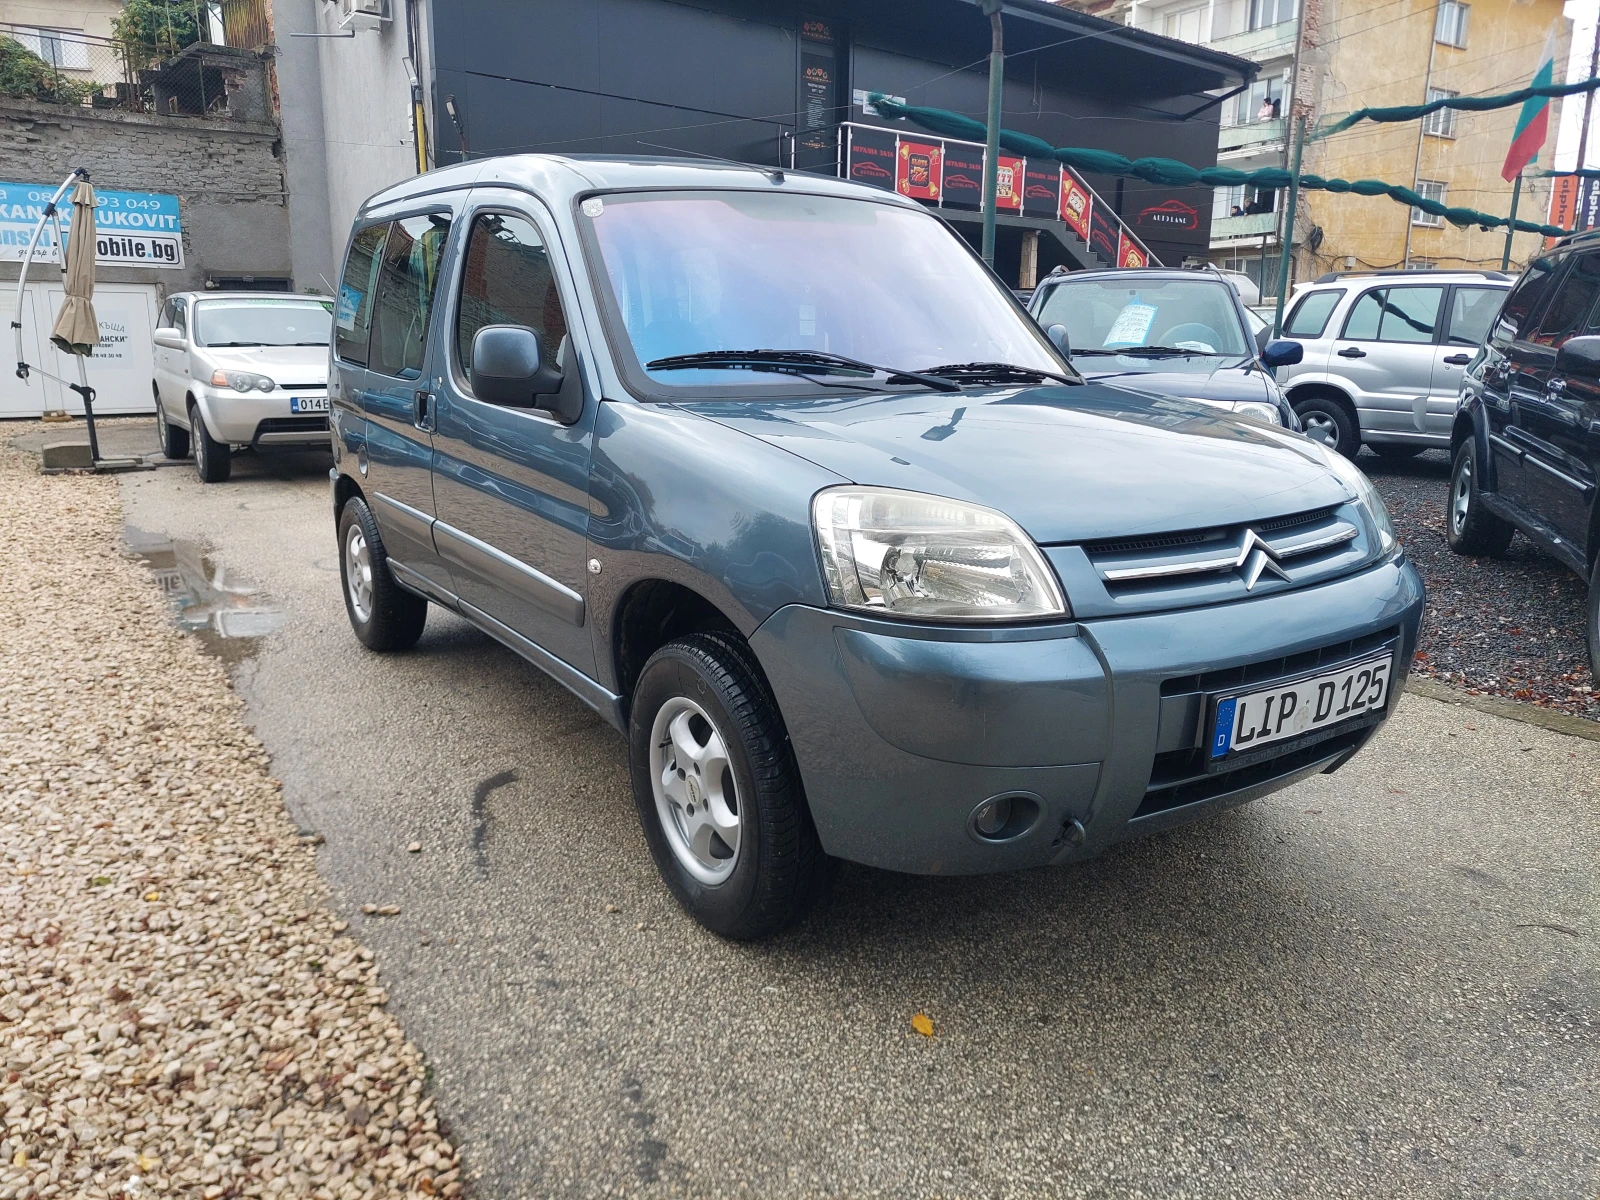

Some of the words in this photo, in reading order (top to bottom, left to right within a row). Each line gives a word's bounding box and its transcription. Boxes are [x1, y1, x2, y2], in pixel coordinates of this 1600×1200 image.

[126, 199, 161, 210] 049
[1558, 179, 1569, 223] alpha
[1587, 180, 1600, 225] alpha
[95, 212, 177, 229] UKOVIT
[97, 237, 175, 261] obile.bg
[98, 321, 125, 333] КЪЩА
[1235, 691, 1298, 745] LIP
[1217, 734, 1226, 747] D
[1281, 740, 1298, 753] KFZ
[1300, 729, 1336, 747] SERVICE
